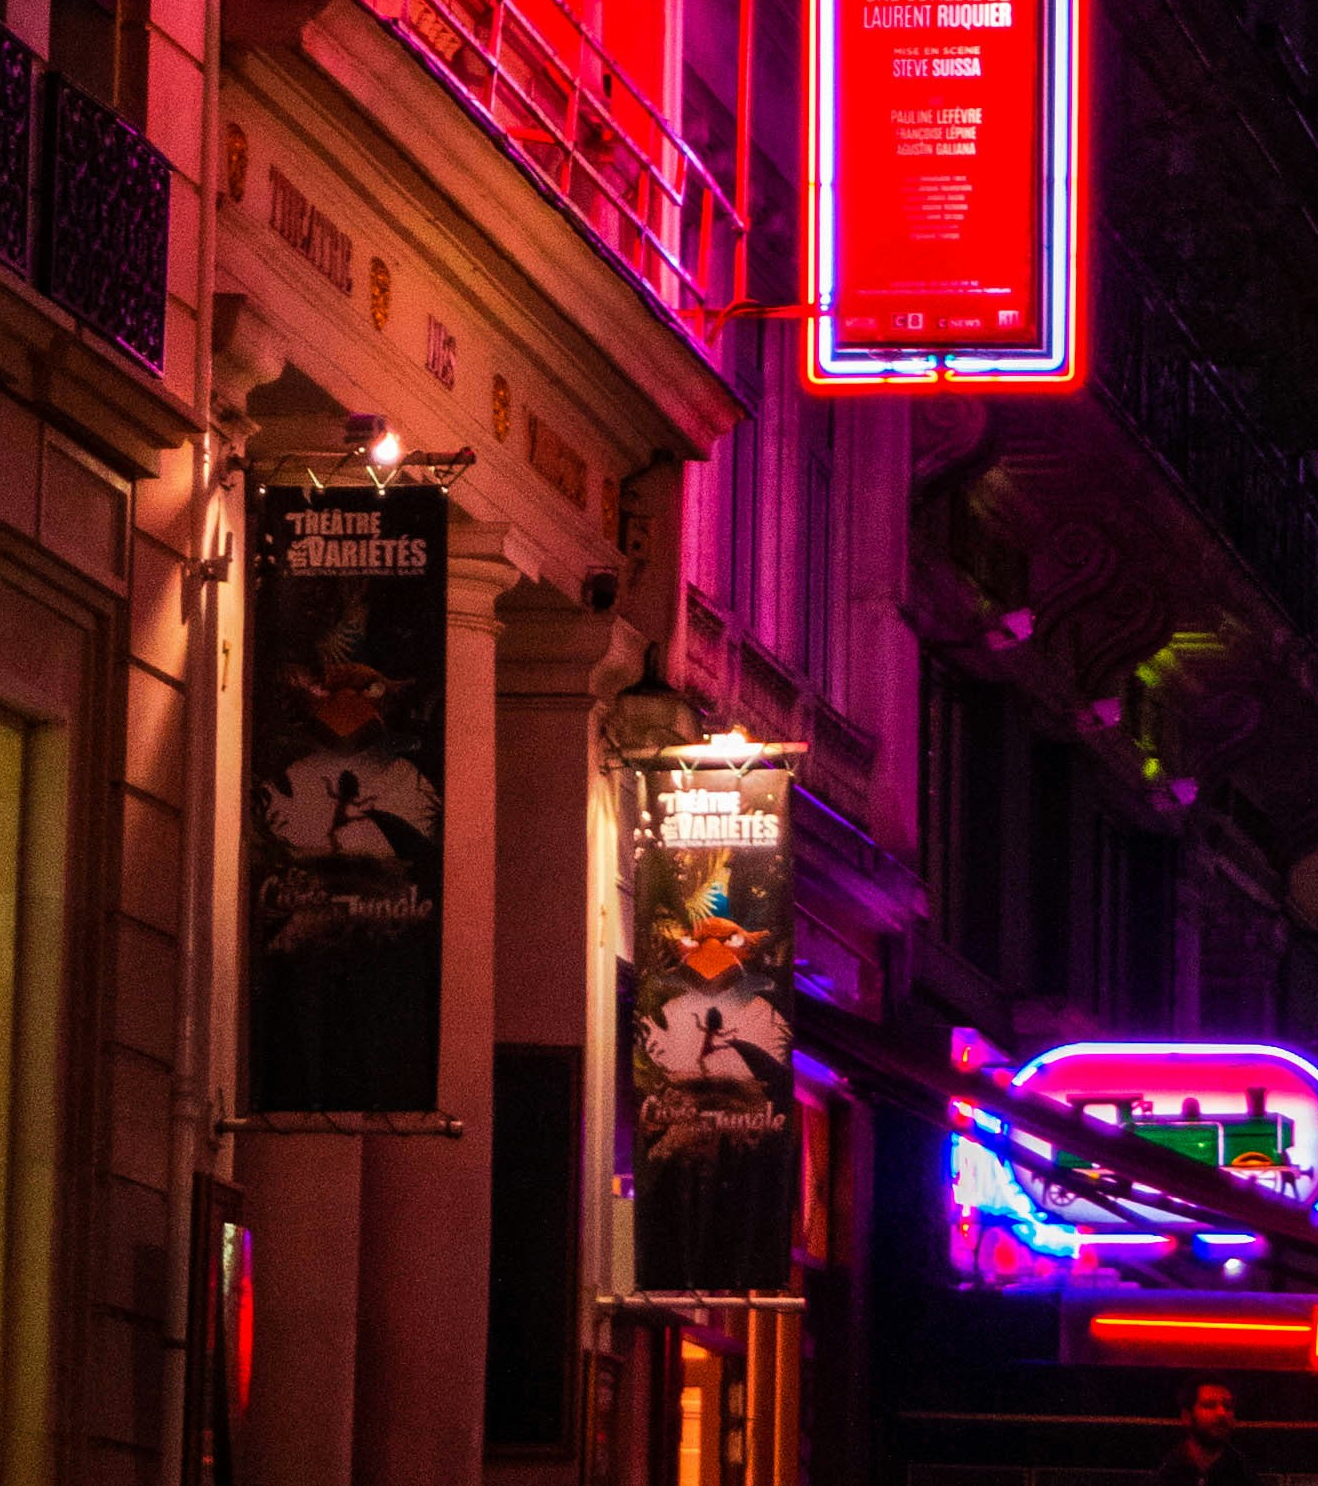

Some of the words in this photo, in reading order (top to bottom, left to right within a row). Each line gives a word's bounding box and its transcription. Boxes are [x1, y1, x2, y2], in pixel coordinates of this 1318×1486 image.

[863, 4, 932, 29] LAURENT
[936, 2, 1013, 30] RUQUIER
[893, 47, 920, 56] MISE
[923, 46, 940, 55] EN
[892, 58, 929, 78] STEVE
[931, 57, 982, 77] SUISSA
[891, 108, 933, 125] PAULINE
[307, 533, 428, 568] VARIÉTÉS
[676, 810, 780, 840] VARIÉTÉS
